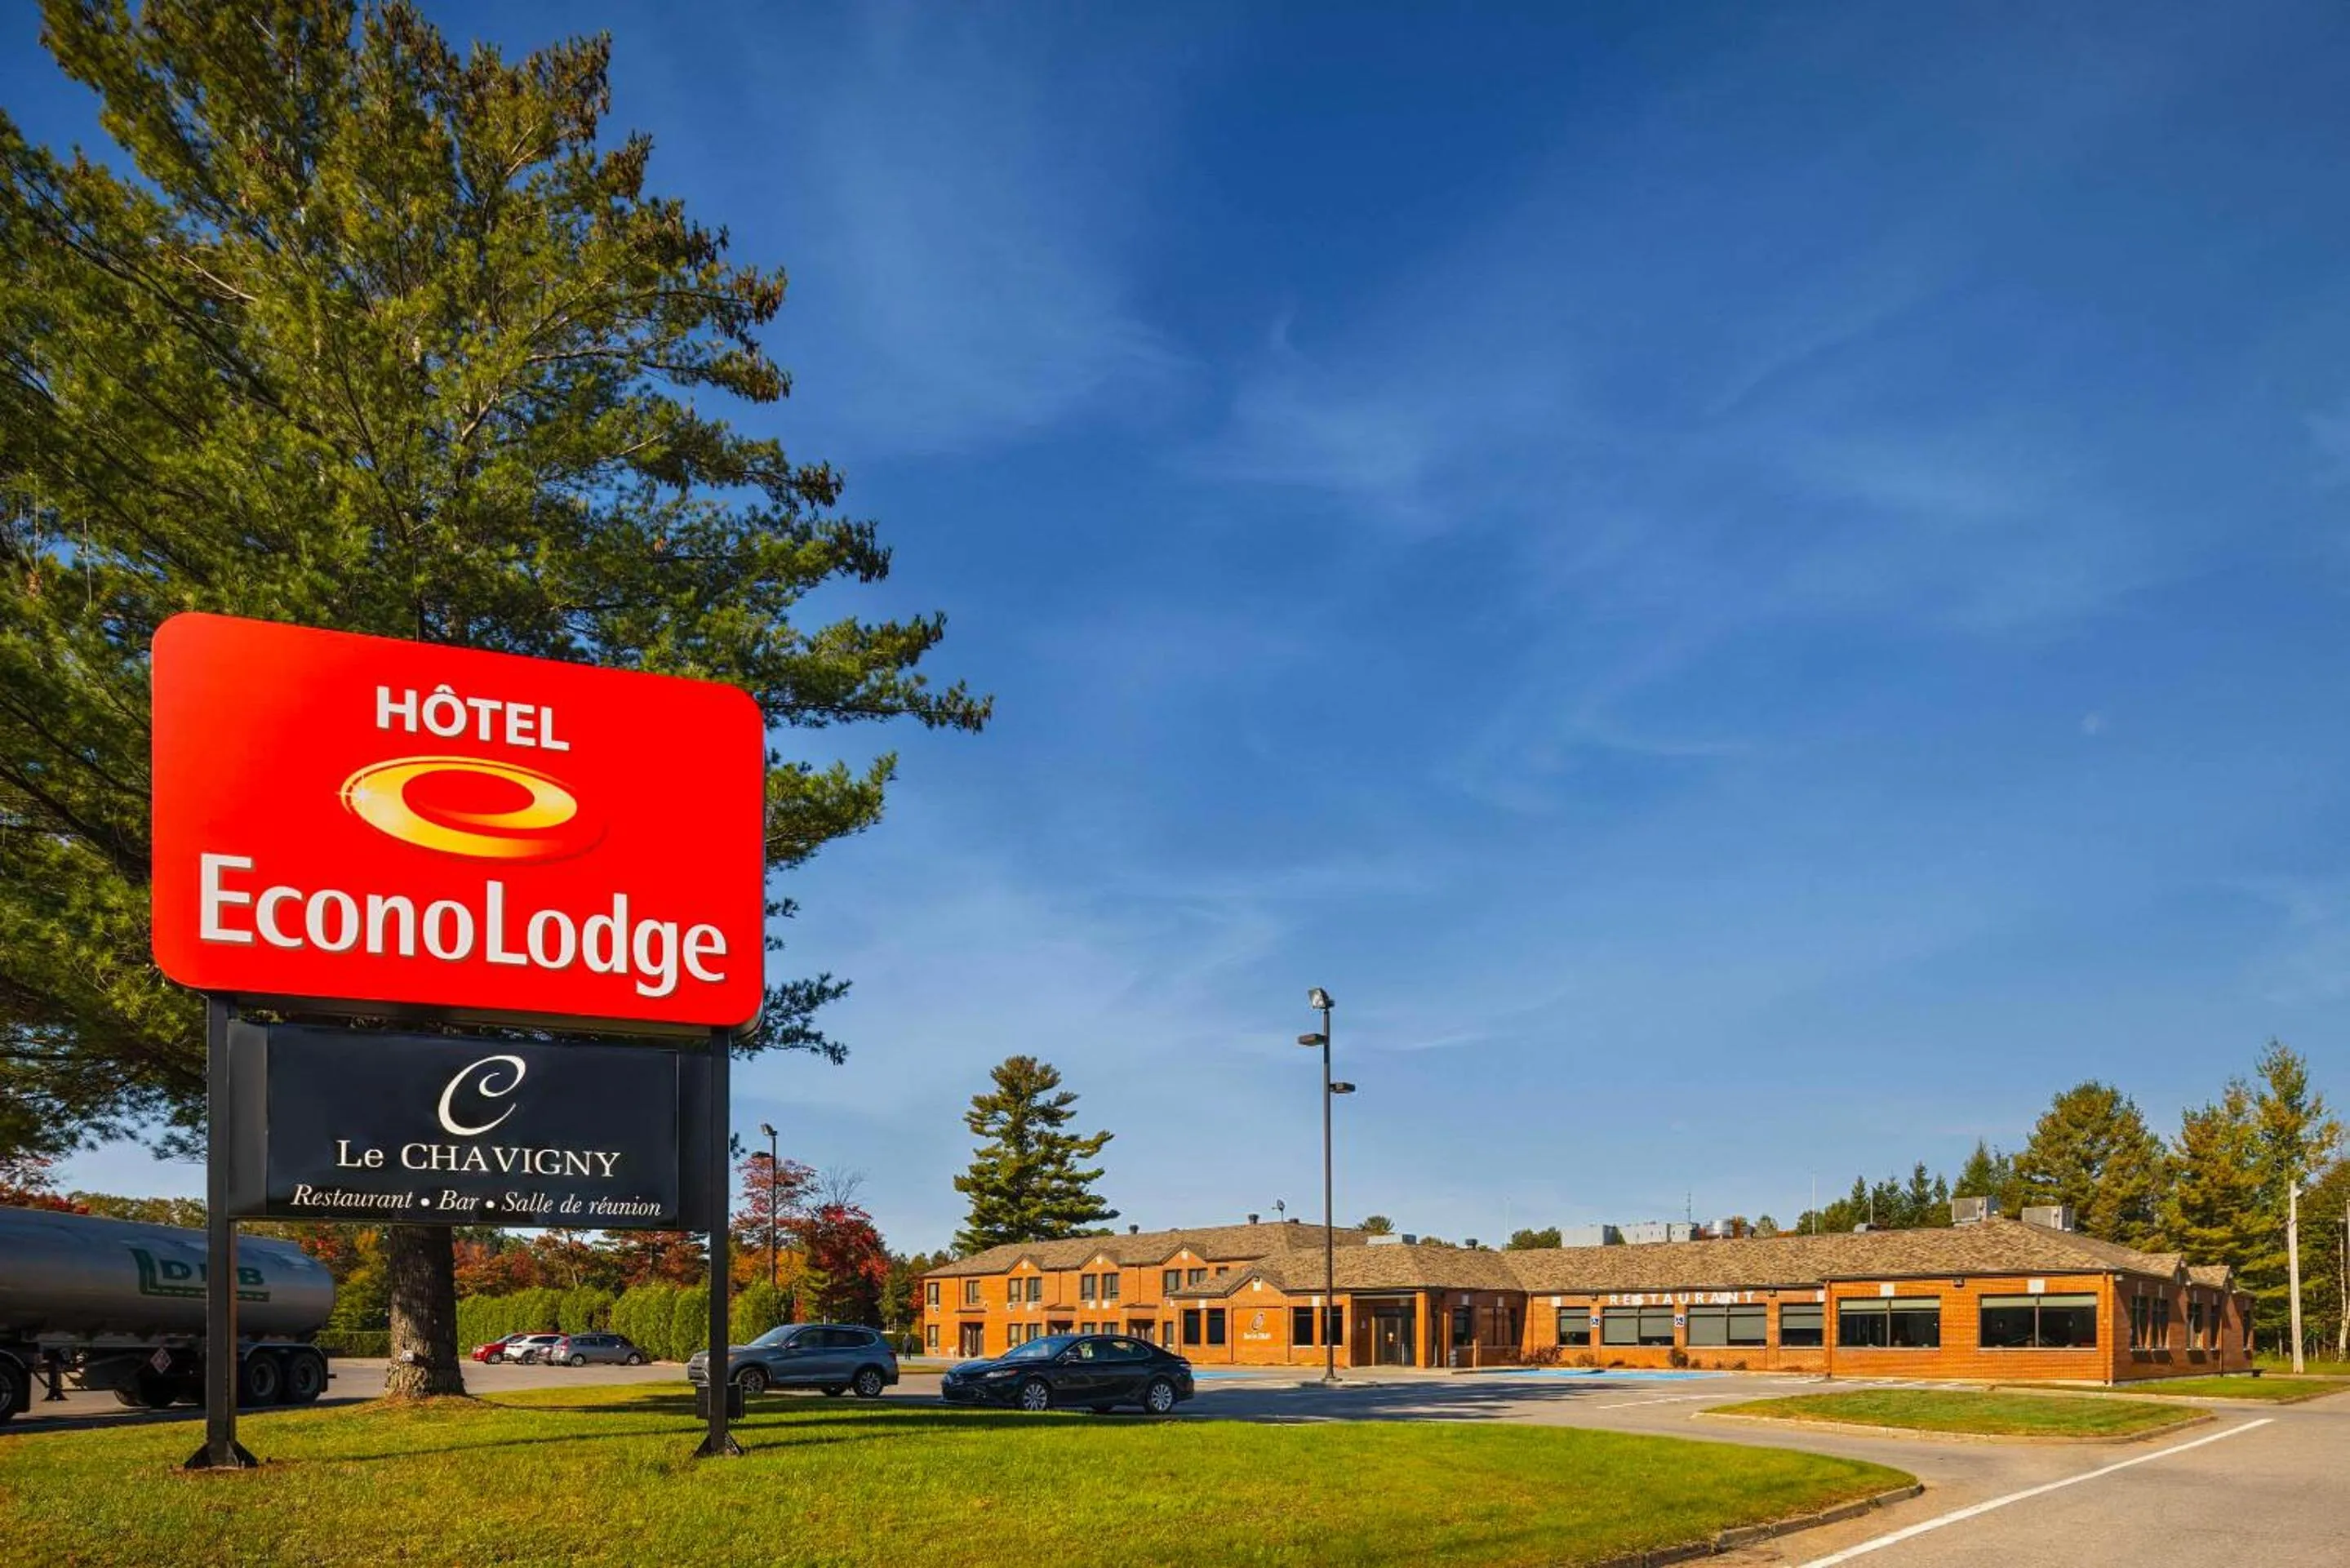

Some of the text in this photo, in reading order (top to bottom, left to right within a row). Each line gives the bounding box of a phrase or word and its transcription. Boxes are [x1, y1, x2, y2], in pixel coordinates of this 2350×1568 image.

[376, 684, 571, 751] HÔTEL
[335, 1139, 620, 1177] Le CHAVIGNY
[290, 1184, 661, 1217] Restaurant Bar Salle de réunion
[1609, 1292, 1755, 1305] RESTAURANT
